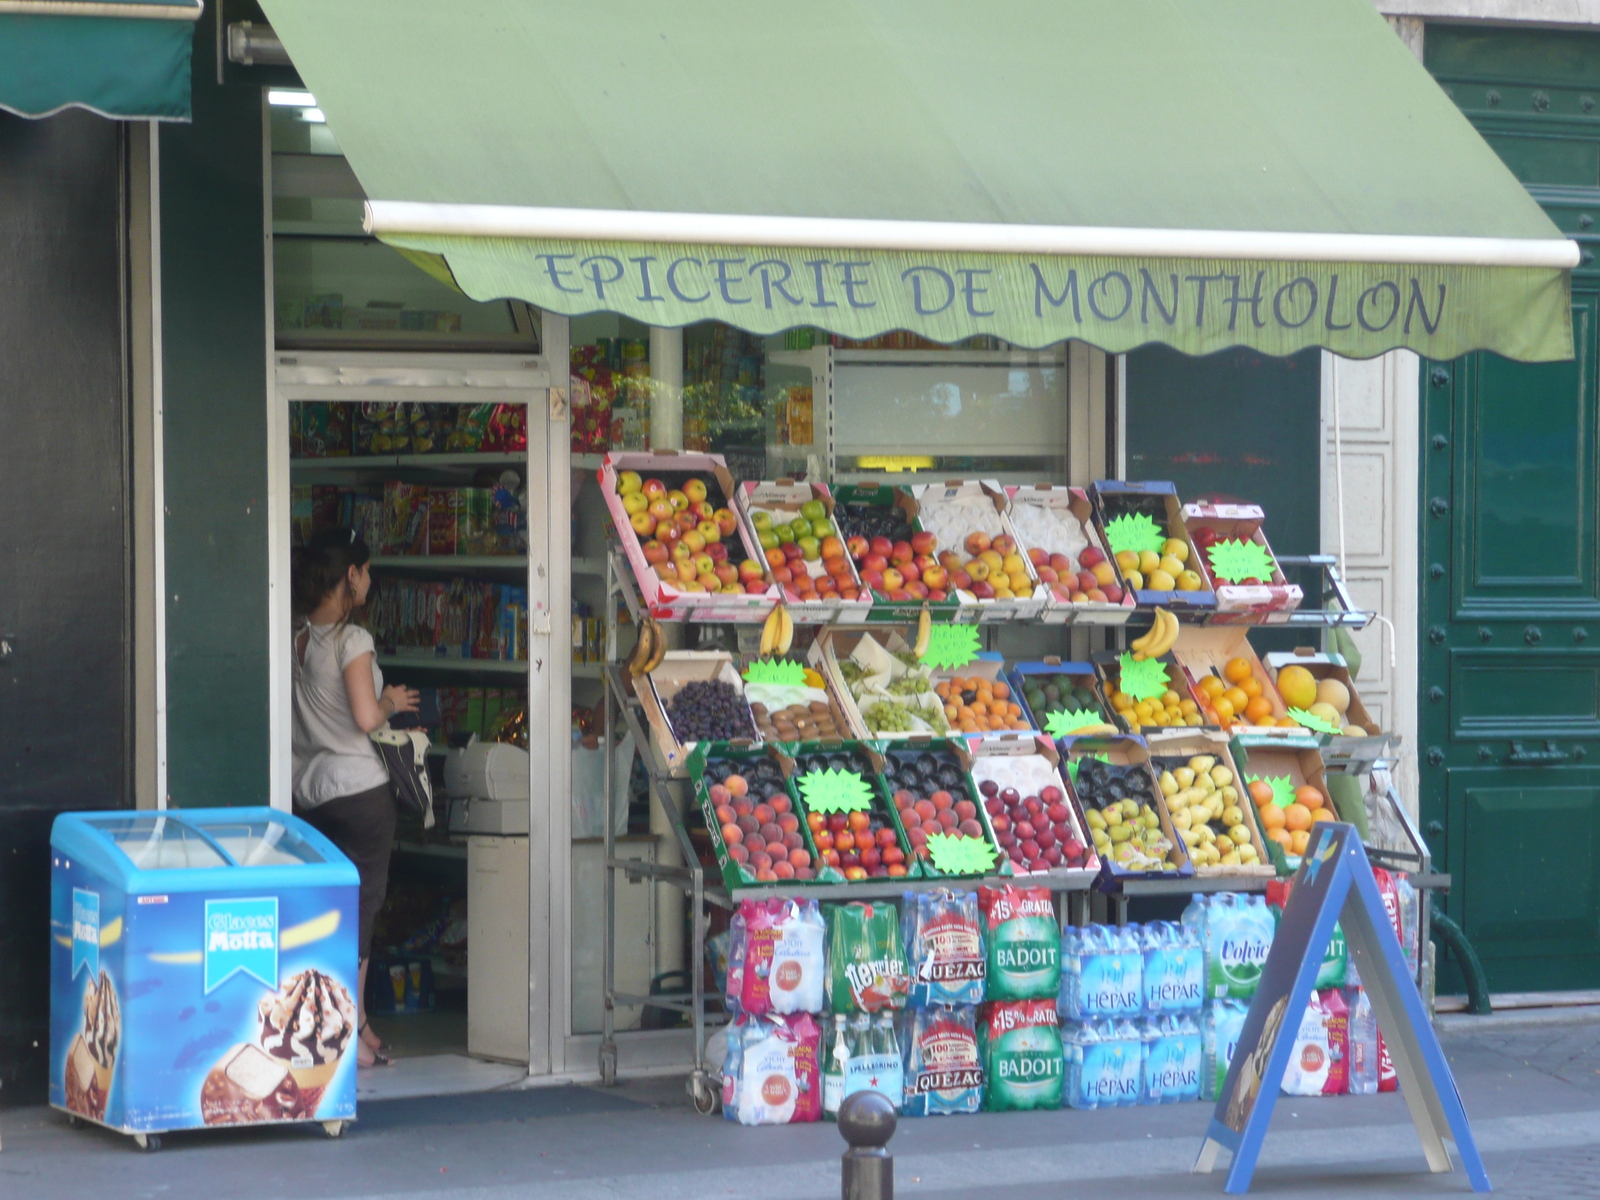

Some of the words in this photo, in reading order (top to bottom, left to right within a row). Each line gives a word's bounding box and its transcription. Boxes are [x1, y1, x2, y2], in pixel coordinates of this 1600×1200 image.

[535, 253, 877, 309] EPICERIE
[901, 265, 995, 316] DE
[1029, 262, 1446, 335] MONTHOLON
[208, 912, 275, 931] Glaces
[208, 930, 275, 951] Motta
[997, 947, 1057, 968] BADOIT
[1221, 939, 1270, 964] Volvic
[998, 1057, 1062, 1078] BADOIT
